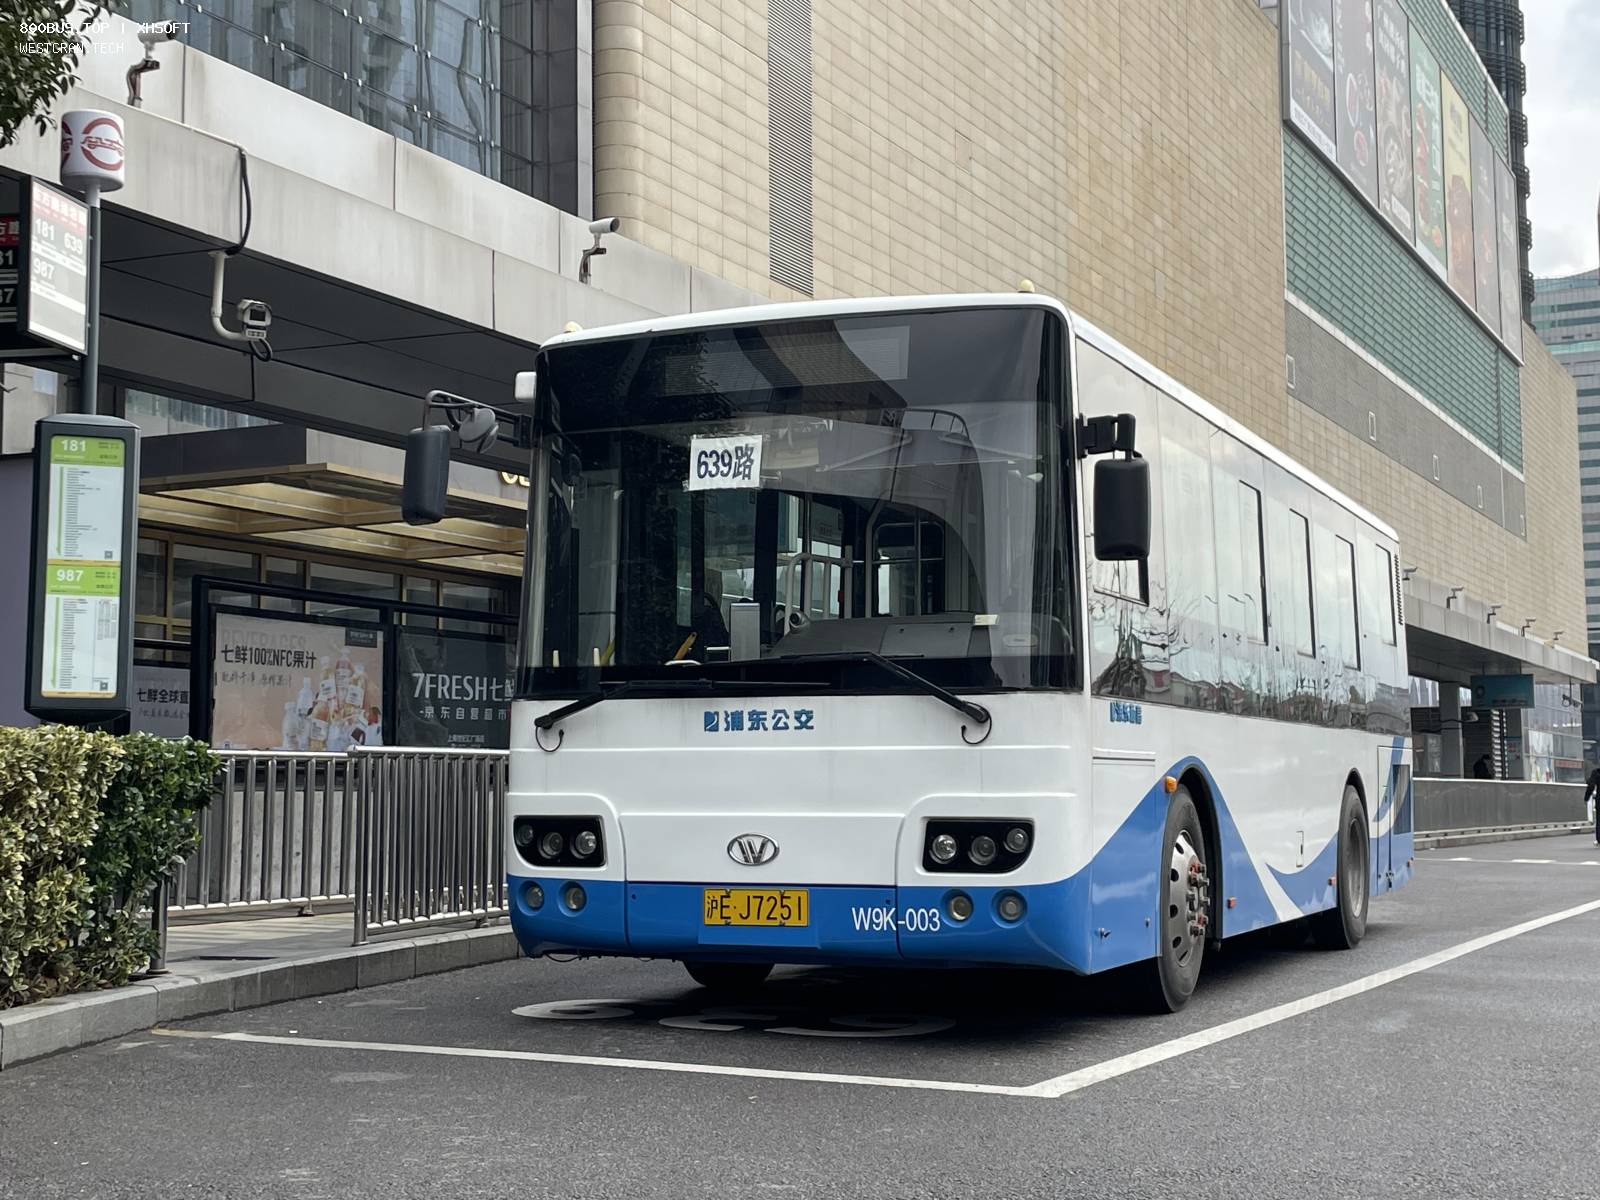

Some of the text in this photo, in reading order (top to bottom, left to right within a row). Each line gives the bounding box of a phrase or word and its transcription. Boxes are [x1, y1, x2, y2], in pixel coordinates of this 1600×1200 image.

[35, 218, 55, 240] 181
[63, 232, 83, 255] 639
[33, 258, 55, 281] 987
[61, 439, 87, 452] 181
[697, 443, 755, 480] 639路
[56, 569, 84, 582] 987
[221, 645, 317, 669] 七鲜100%NFC果汁
[724, 709, 815, 732] 浦东公交
[851, 907, 941, 932] W9K-003
